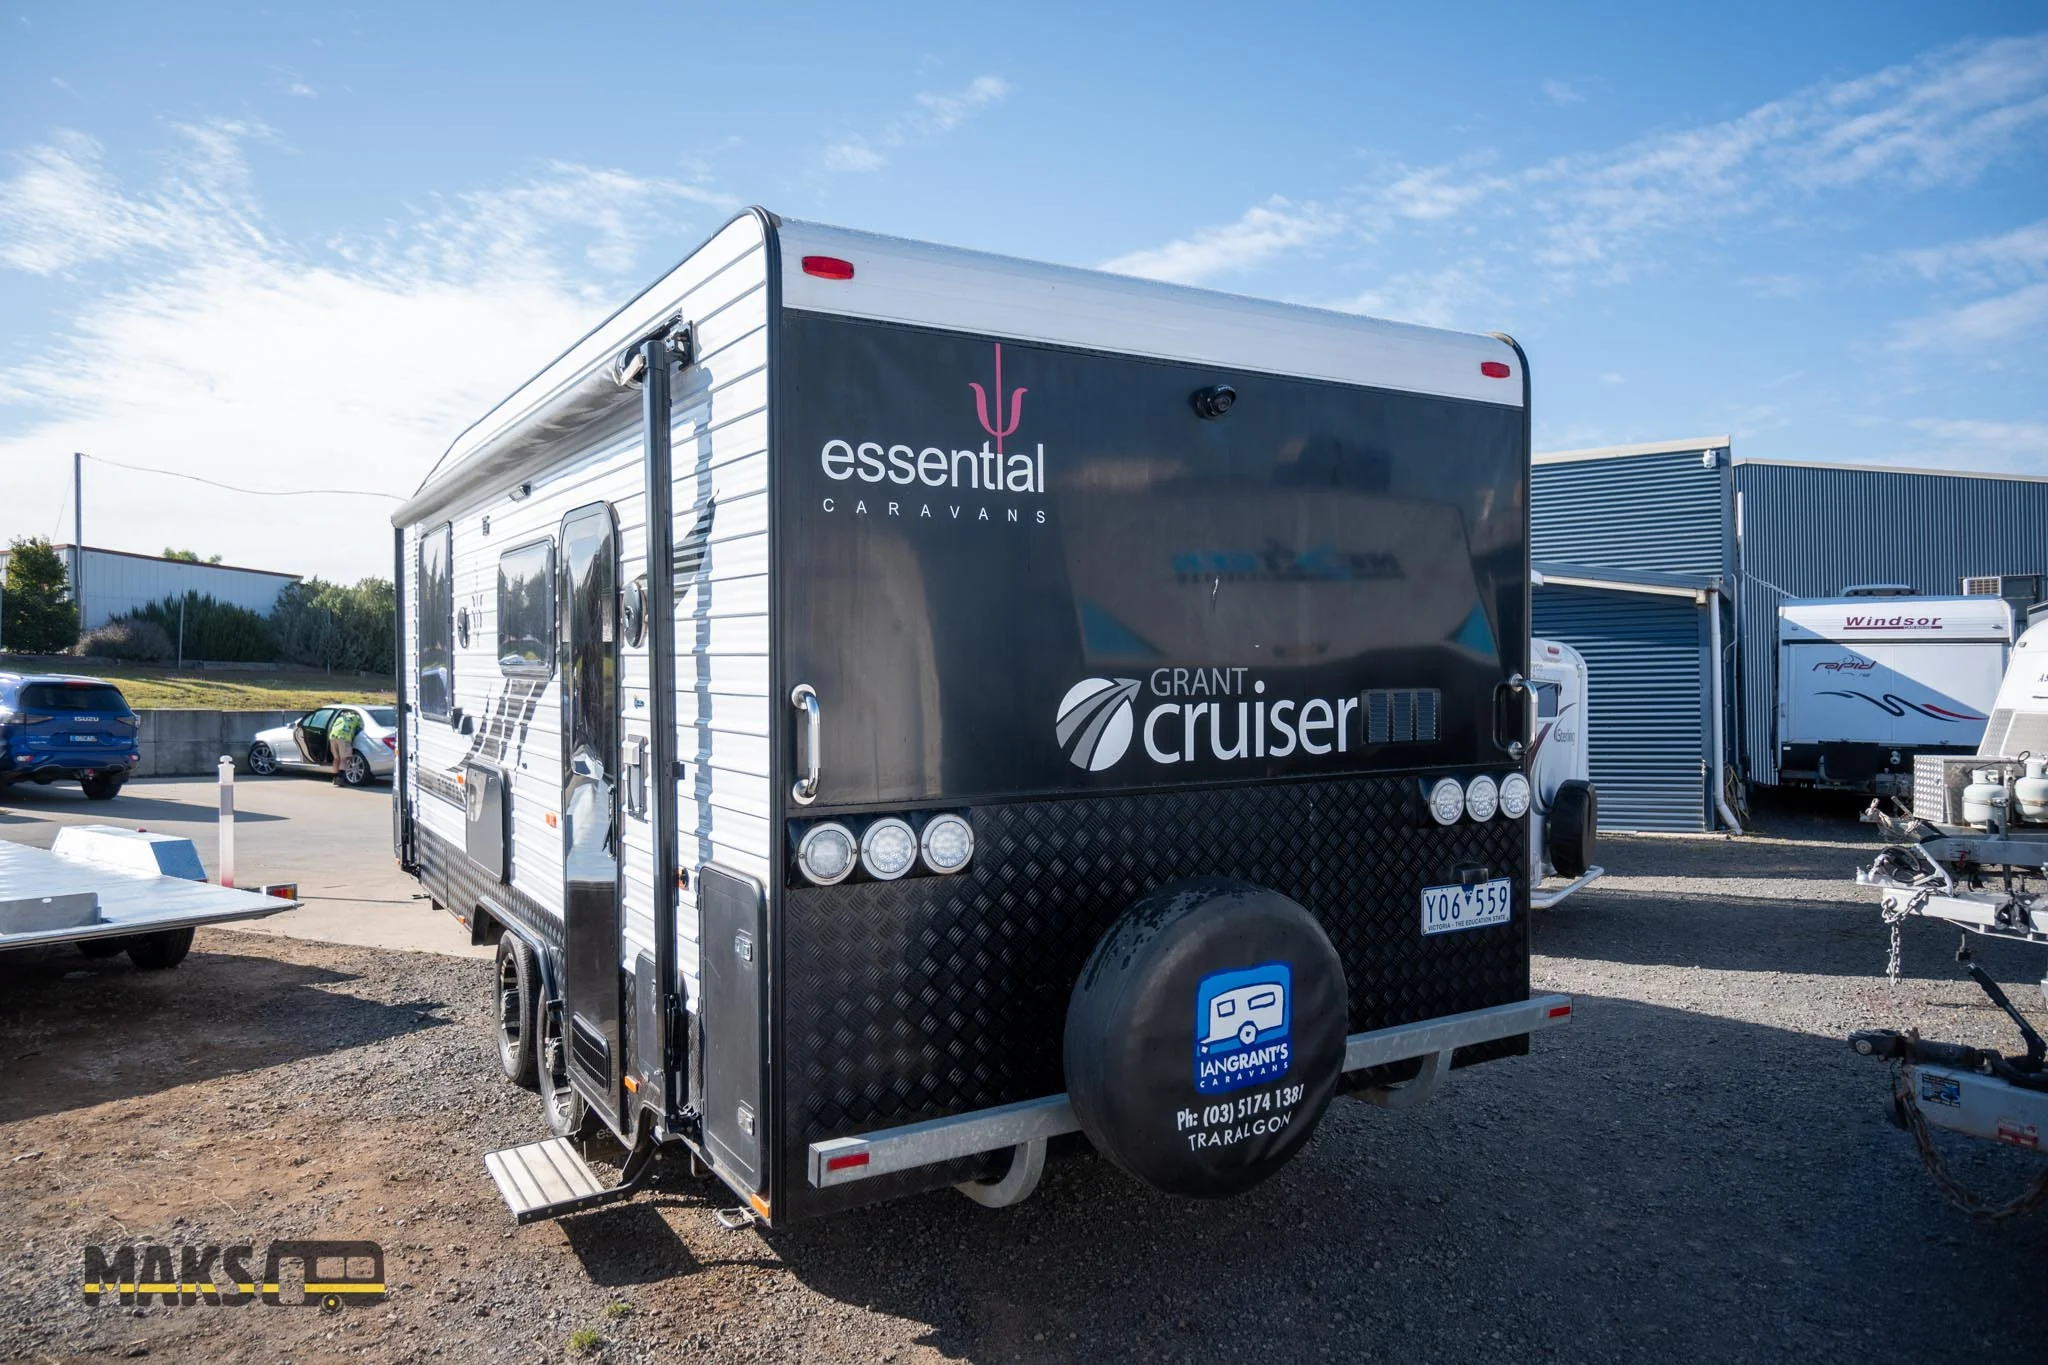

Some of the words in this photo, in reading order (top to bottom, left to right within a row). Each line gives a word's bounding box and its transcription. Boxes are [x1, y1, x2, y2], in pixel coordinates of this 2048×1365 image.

[821, 439, 1044, 493] essential
[823, 498, 1045, 523] CARAVANS
[1846, 616, 1942, 626] Windsor
[1812, 660, 1877, 672] rapid
[1150, 667, 1248, 696] GRANT
[1143, 680, 1358, 764] cruiser
[1426, 893, 1460, 923] Y06
[1476, 886, 1507, 916] 559
[1428, 923, 1451, 932] VICTORIA
[1465, 917, 1491, 927] EDUCATION
[1492, 914, 1506, 922] STATE
[1200, 1062, 1289, 1088] CARAVANS
[1177, 1108, 1199, 1131] Ph:
[1203, 1102, 1234, 1128] (03)
[1238, 1094, 1271, 1119] 5174
[1275, 1083, 1305, 1108] 1381
[1188, 1111, 1292, 1151] TRARALGON
